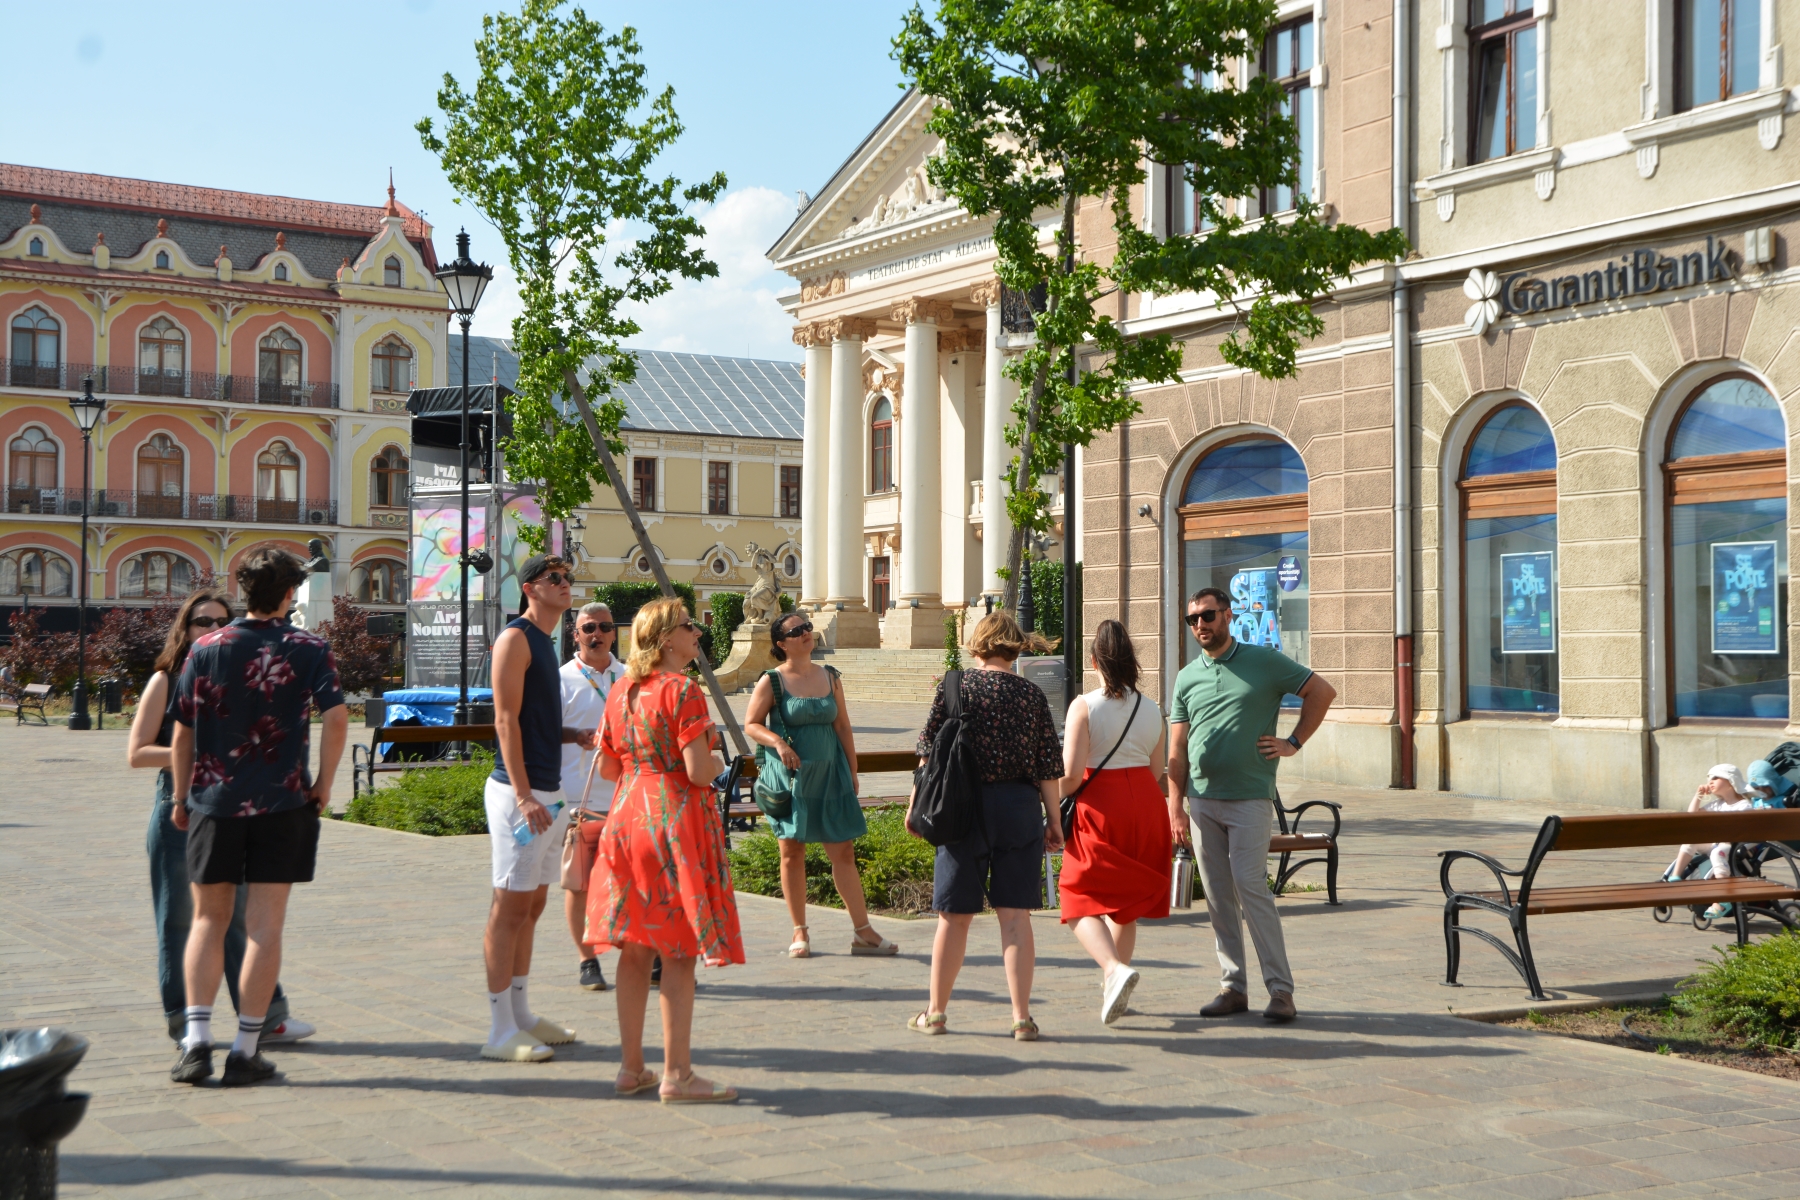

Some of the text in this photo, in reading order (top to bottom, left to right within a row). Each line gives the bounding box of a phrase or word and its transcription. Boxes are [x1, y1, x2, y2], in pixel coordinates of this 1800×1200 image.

[868, 259, 906, 280] TEATRUL
[907, 256, 920, 271] DE
[922, 249, 944, 266] STAT
[1502, 235, 1731, 314] GarantiBank
[1521, 563, 1535, 580] SE
[1735, 554, 1752, 570] SE
[432, 610, 462, 624] Art
[1229, 611, 1282, 651] OA
